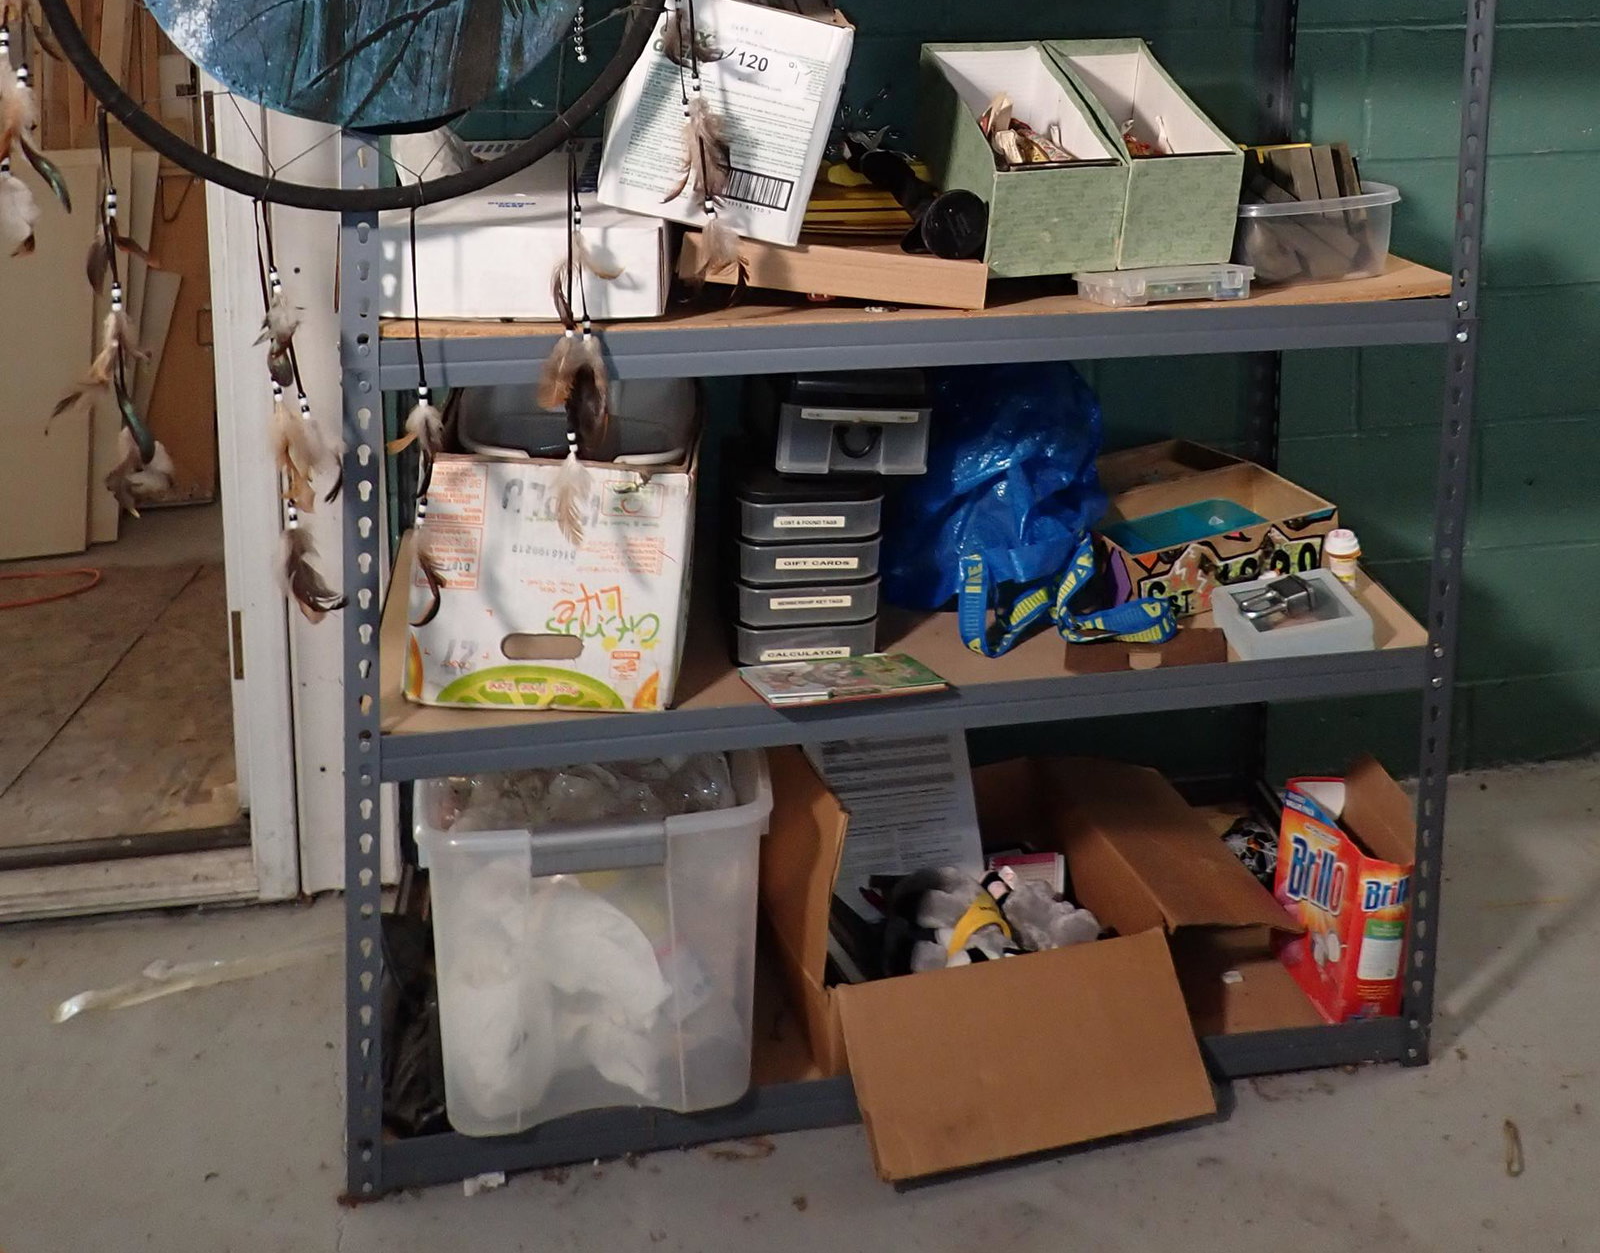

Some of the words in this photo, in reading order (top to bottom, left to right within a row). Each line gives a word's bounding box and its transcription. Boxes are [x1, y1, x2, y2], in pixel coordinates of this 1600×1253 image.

[738, 51, 769, 72] 120
[552, 582, 622, 630] Life
[767, 650, 842, 658] CALCULATOR
[1288, 834, 1346, 915] Brillo
